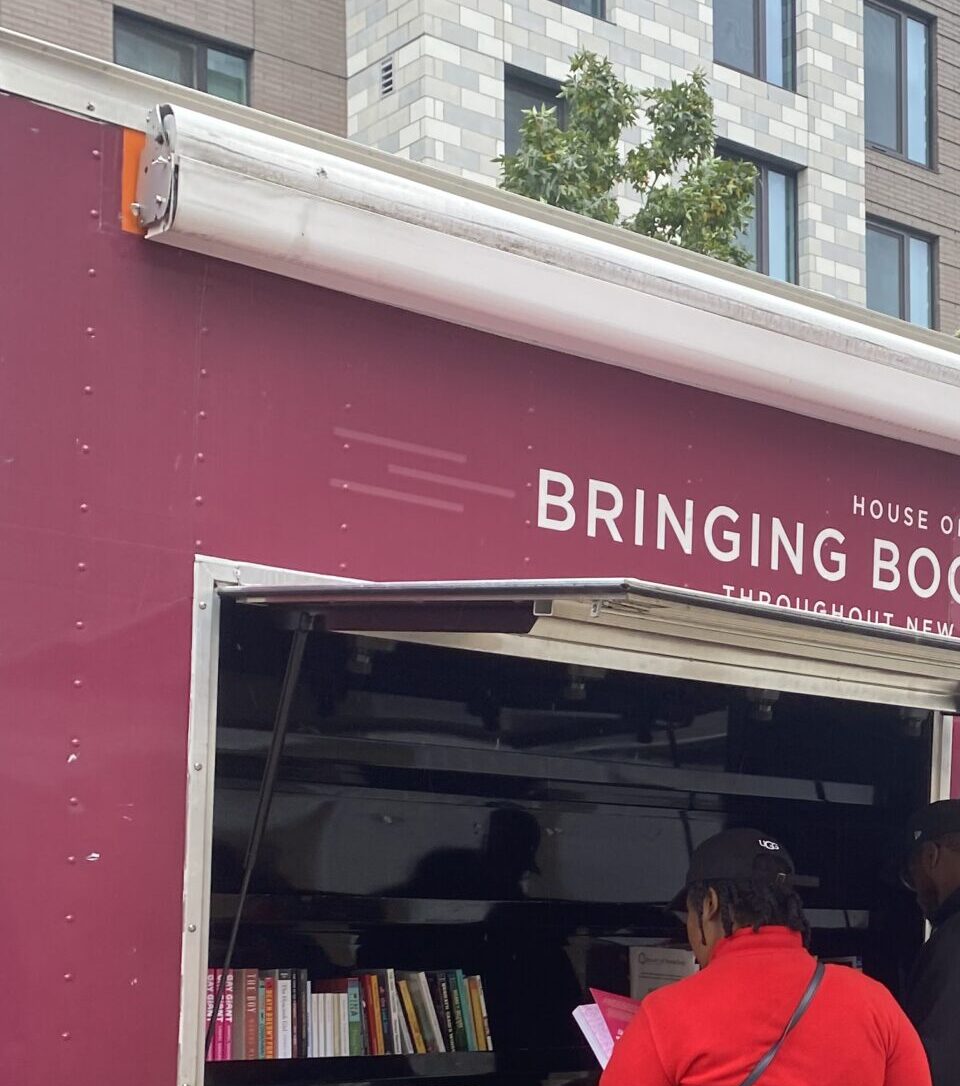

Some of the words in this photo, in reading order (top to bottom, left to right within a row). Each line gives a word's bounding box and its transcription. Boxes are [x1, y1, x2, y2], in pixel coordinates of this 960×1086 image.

[537, 468, 847, 582] BRINGING
[853, 494, 929, 530] HOUSE
[907, 616, 954, 638] NEW
[758, 839, 780, 850] UGG
[225, 974, 233, 992] GAY
[225, 993, 233, 1023] GIANT
